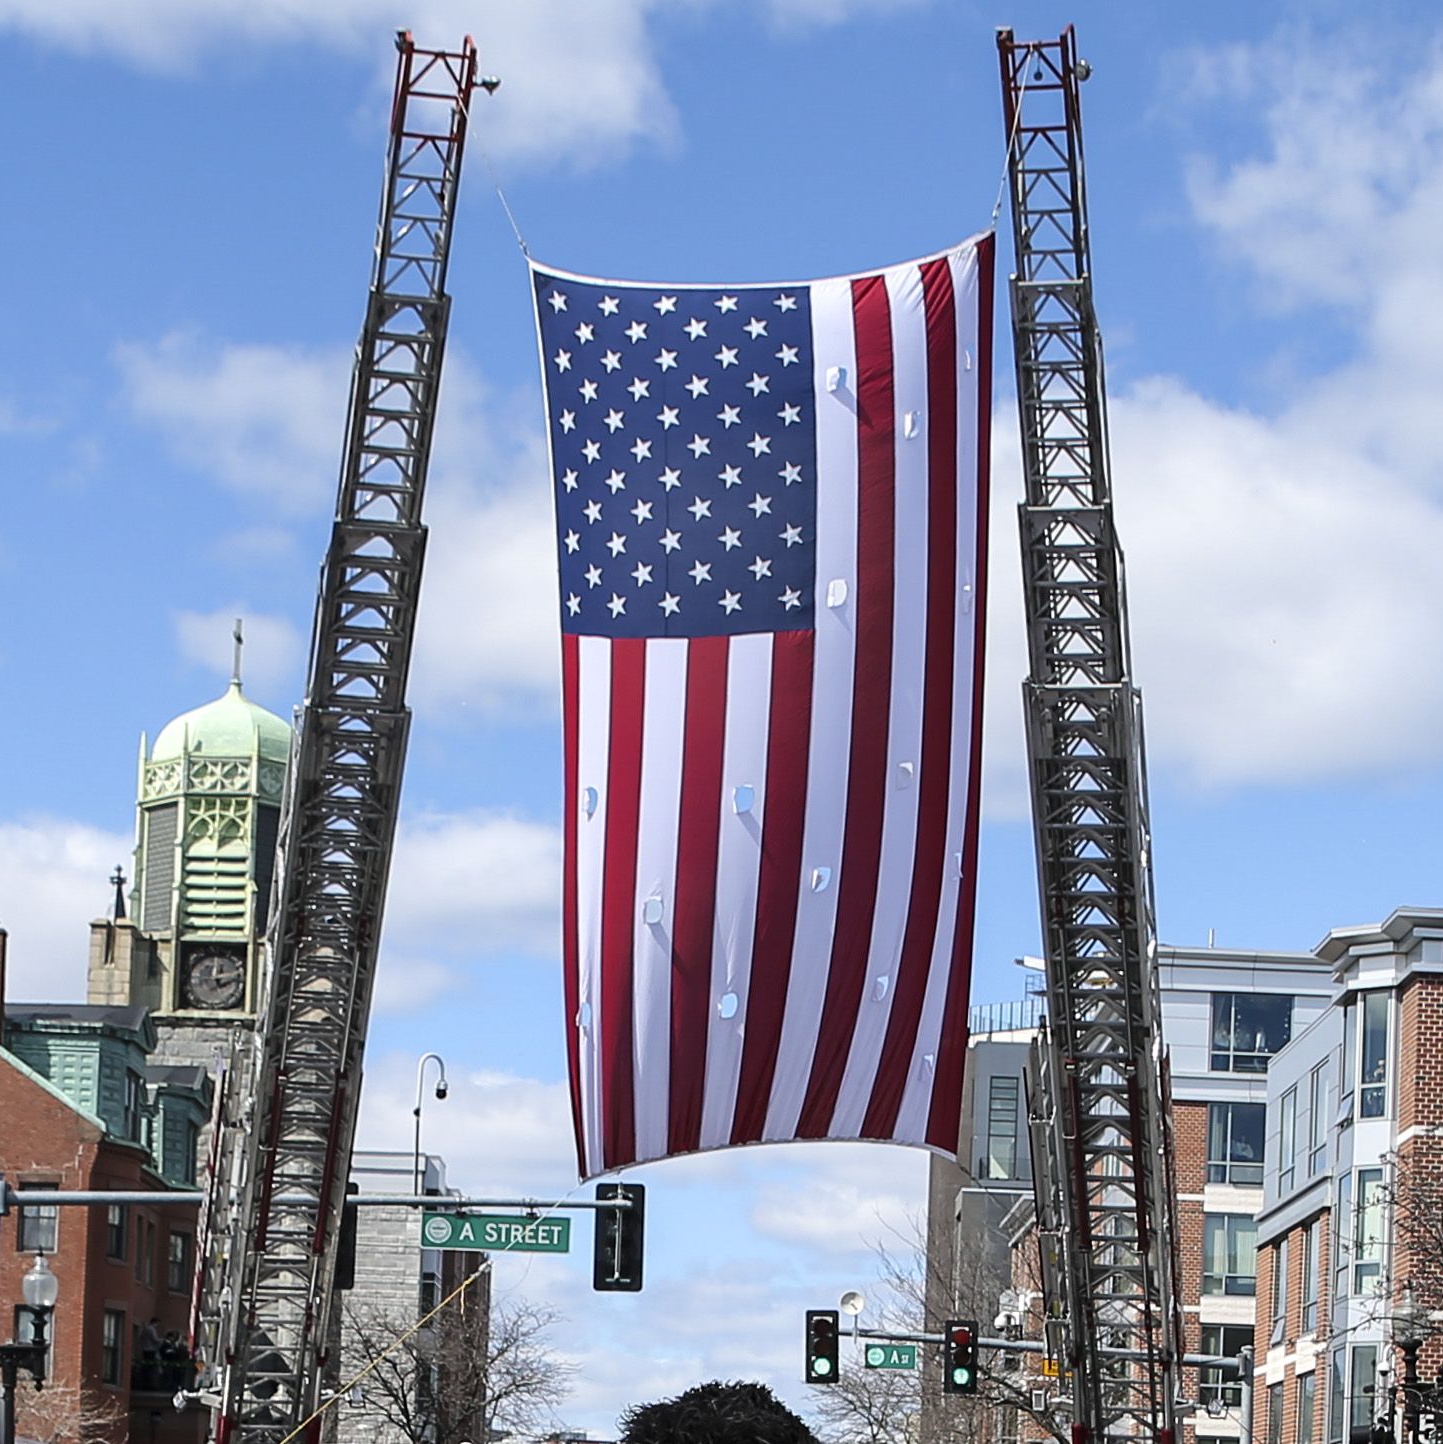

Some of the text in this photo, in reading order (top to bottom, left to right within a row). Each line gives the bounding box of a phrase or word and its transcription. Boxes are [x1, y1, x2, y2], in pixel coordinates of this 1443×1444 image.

[458, 1222, 475, 1242] A
[484, 1223, 562, 1245] STREET
[890, 1349, 909, 1364] A ST
